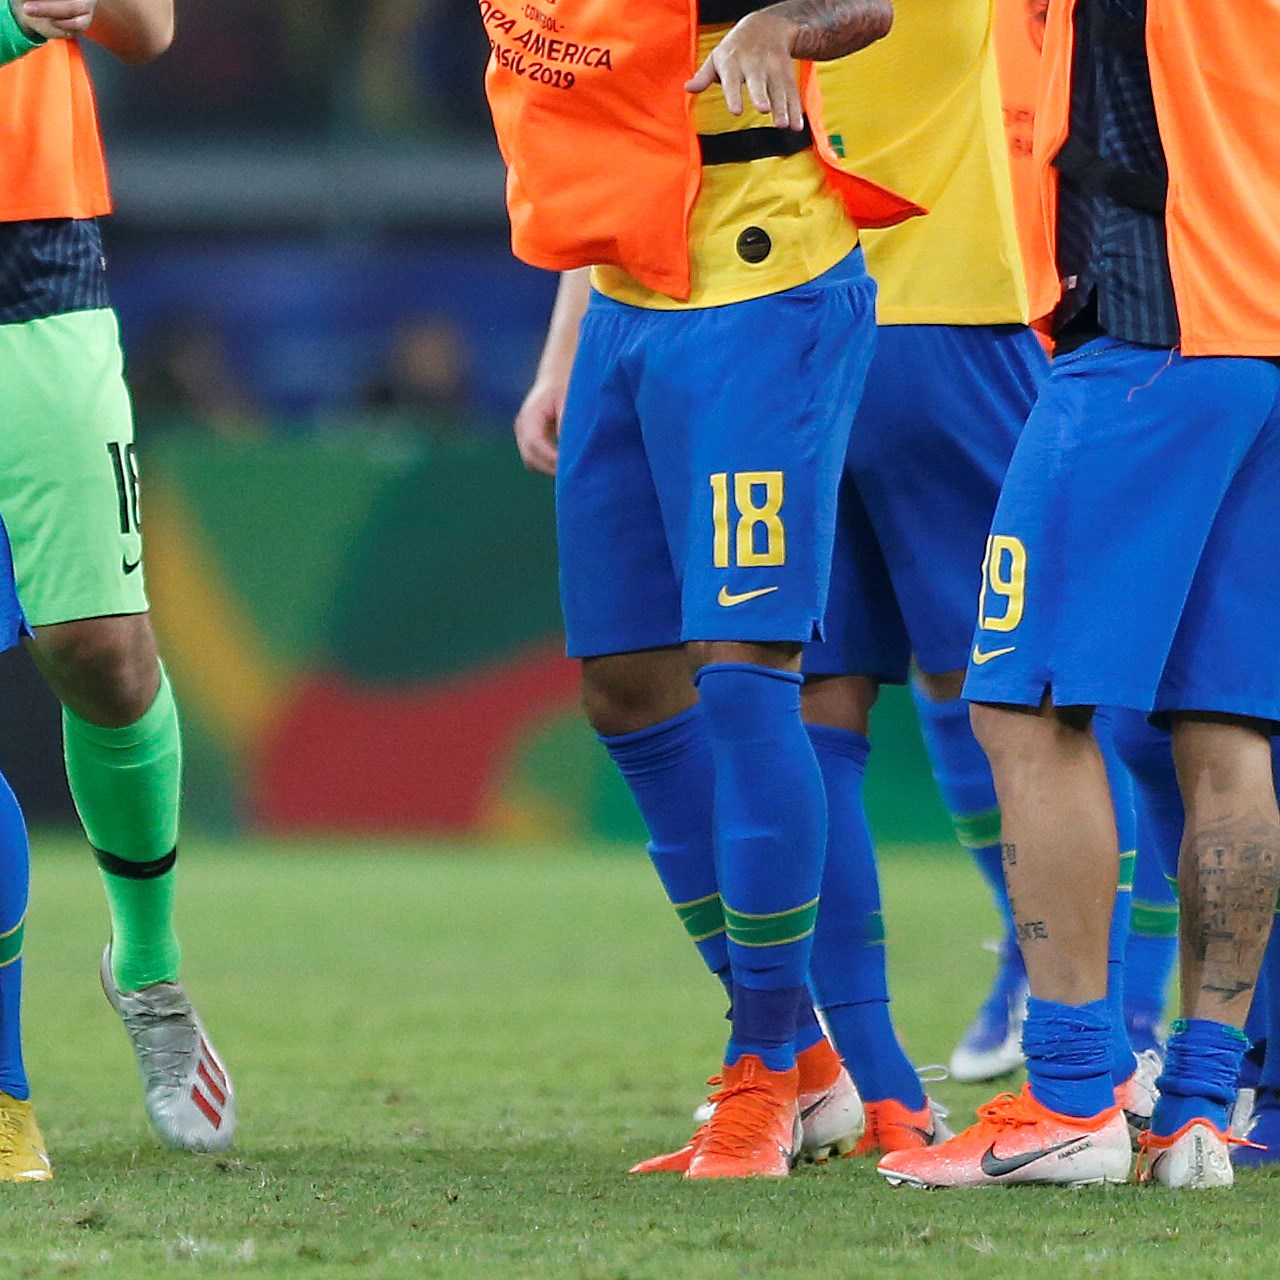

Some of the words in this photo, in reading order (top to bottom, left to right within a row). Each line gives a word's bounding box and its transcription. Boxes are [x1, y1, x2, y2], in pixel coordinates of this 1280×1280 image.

[479, 0, 517, 36] OPA
[512, 28, 613, 72] AMERICA
[527, 61, 577, 91] 2019
[708, 470, 786, 570] 18
